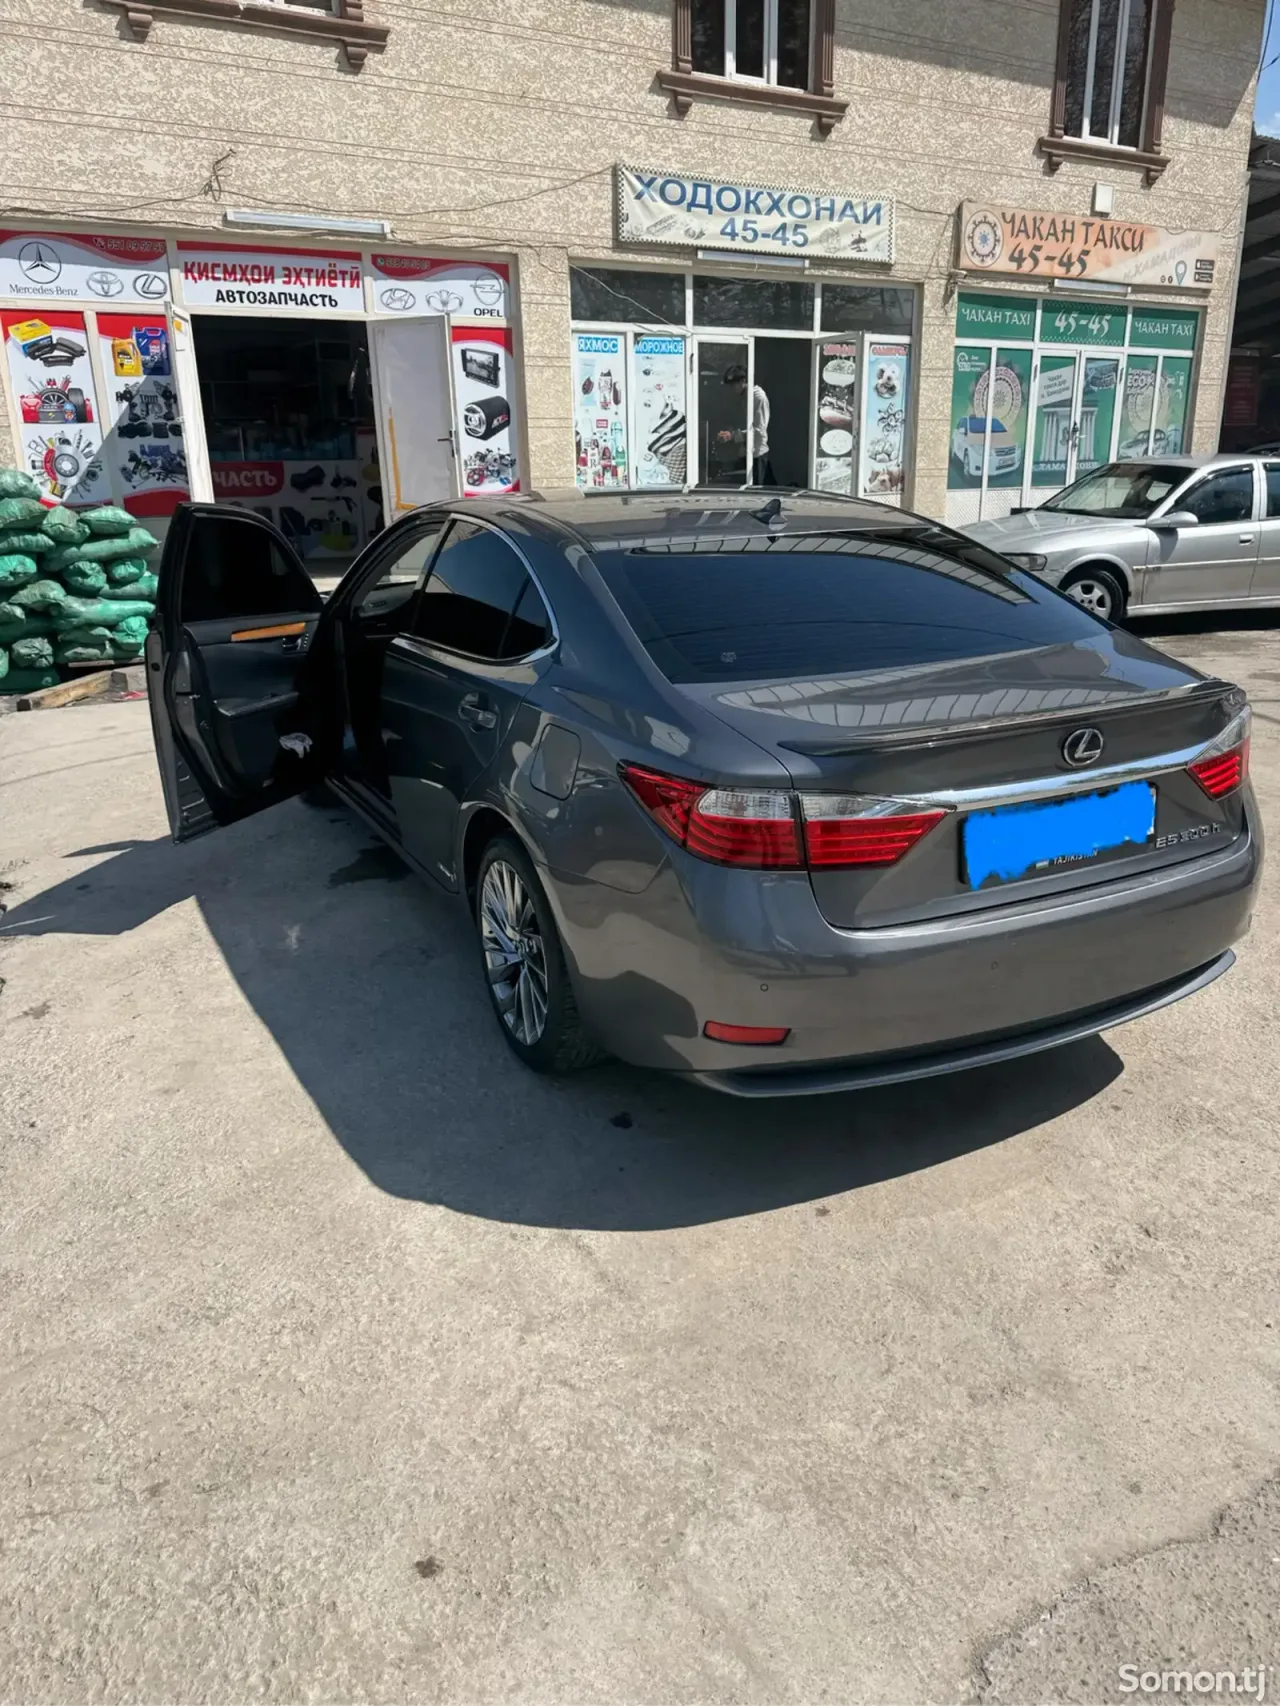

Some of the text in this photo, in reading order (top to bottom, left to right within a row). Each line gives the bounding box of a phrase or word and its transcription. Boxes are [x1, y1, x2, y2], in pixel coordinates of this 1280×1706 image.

[634, 175, 882, 226] ХОДОКХОНАИ
[720, 217, 809, 248] 45-45
[1001, 211, 1145, 252] ЧАКАН ТАКСИ
[1008, 243, 1091, 277] 45-45
[184, 261, 275, 286] ҚИСМҲОИ
[9, 284, 79, 296] Mercedes-Benz
[215, 289, 339, 308] АВТОЗАПЧАСТЬ
[473, 307, 503, 318] OPEL
[962, 307, 1031, 326] ЧАКАН TAXI
[1054, 309, 1112, 337] 45-45
[1134, 320, 1194, 337] ЧАКАН TAXI
[579, 338, 618, 353] ЯХМОС
